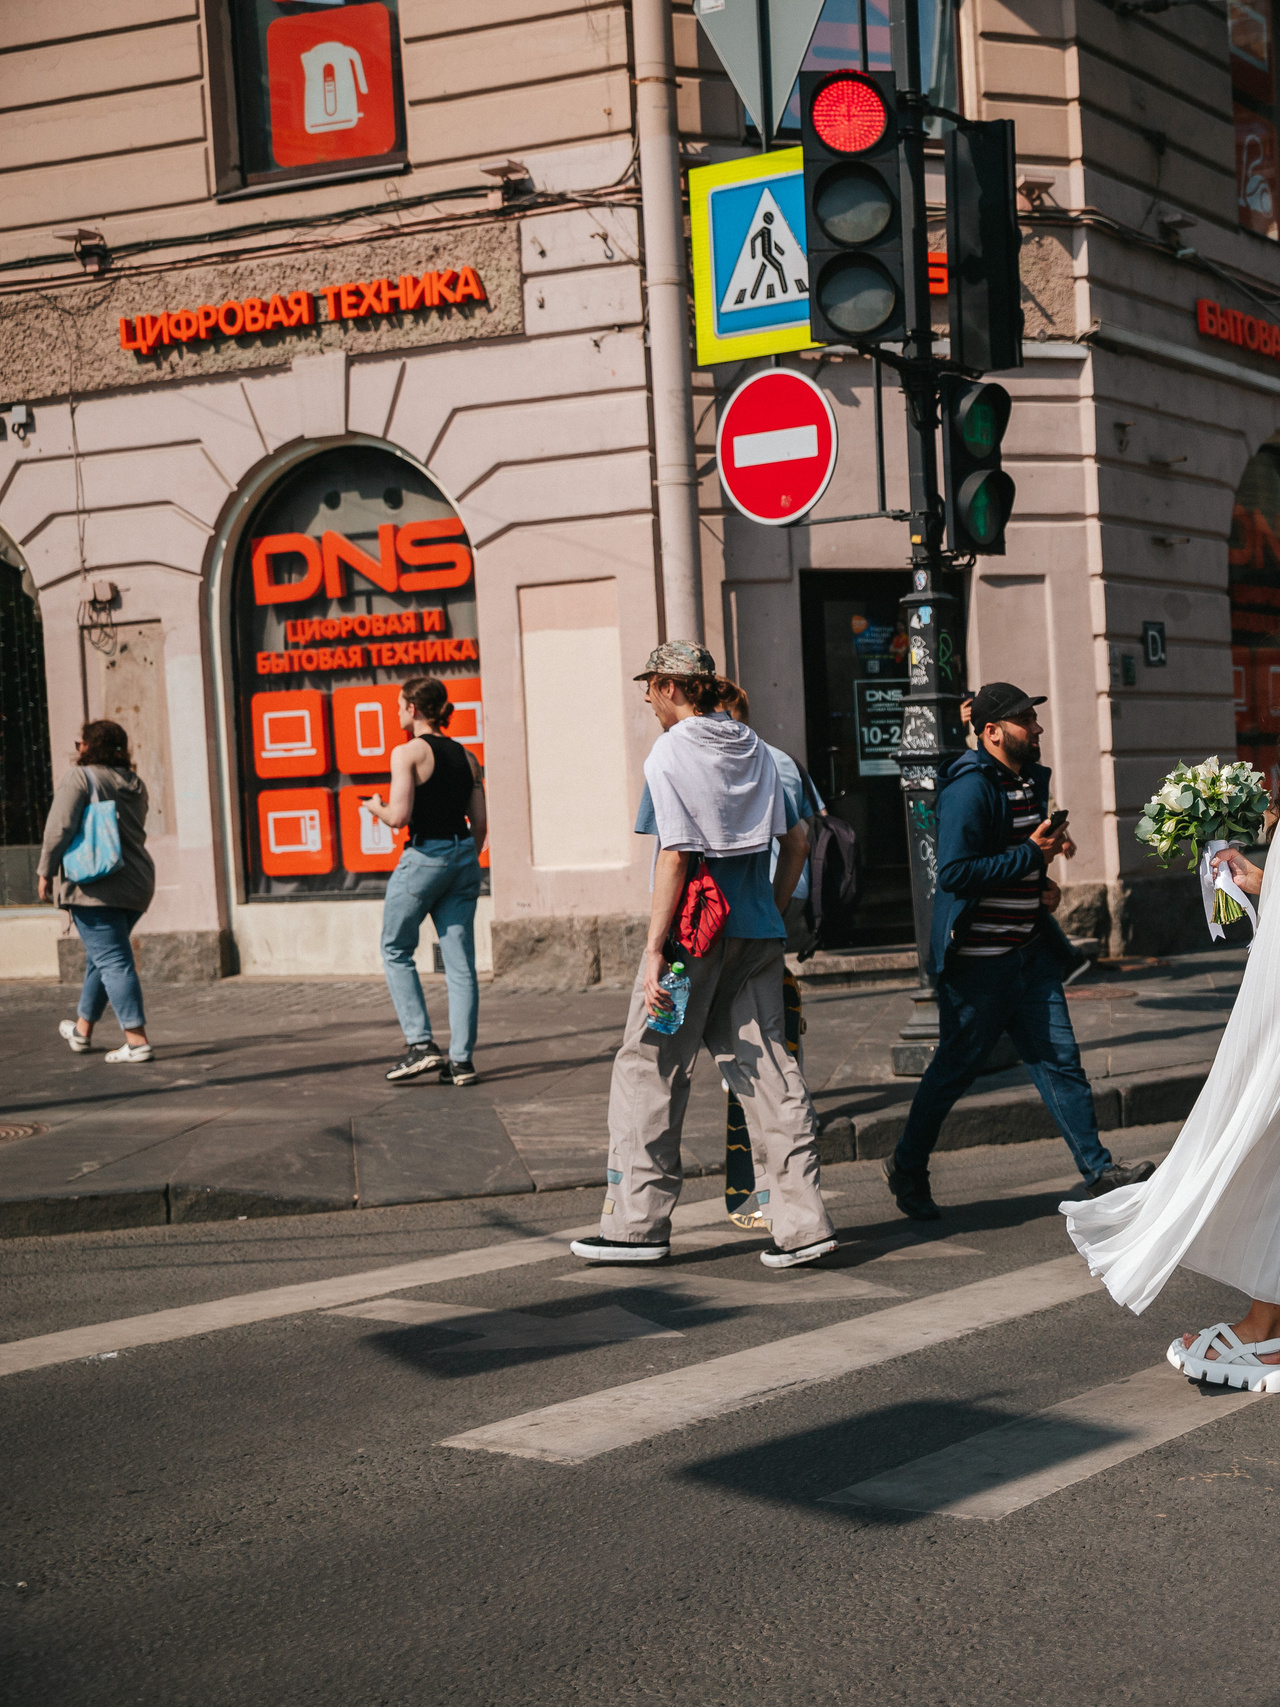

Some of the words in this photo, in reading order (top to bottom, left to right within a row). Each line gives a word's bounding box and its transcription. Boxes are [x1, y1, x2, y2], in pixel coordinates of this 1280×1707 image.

[118, 290, 313, 355] ЦИФРОВАЯ
[320, 265, 486, 321] ТЕХНИКА
[251, 516, 473, 606] DNS
[285, 610, 421, 646] ЦИФРОВАЯ
[422, 609, 446, 633] И
[256, 644, 367, 676] БЫТОВАЯ
[367, 637, 479, 667] ТЕХНИКА
[866, 689, 904, 702] DNS
[861, 725, 901, 745] 10-2
